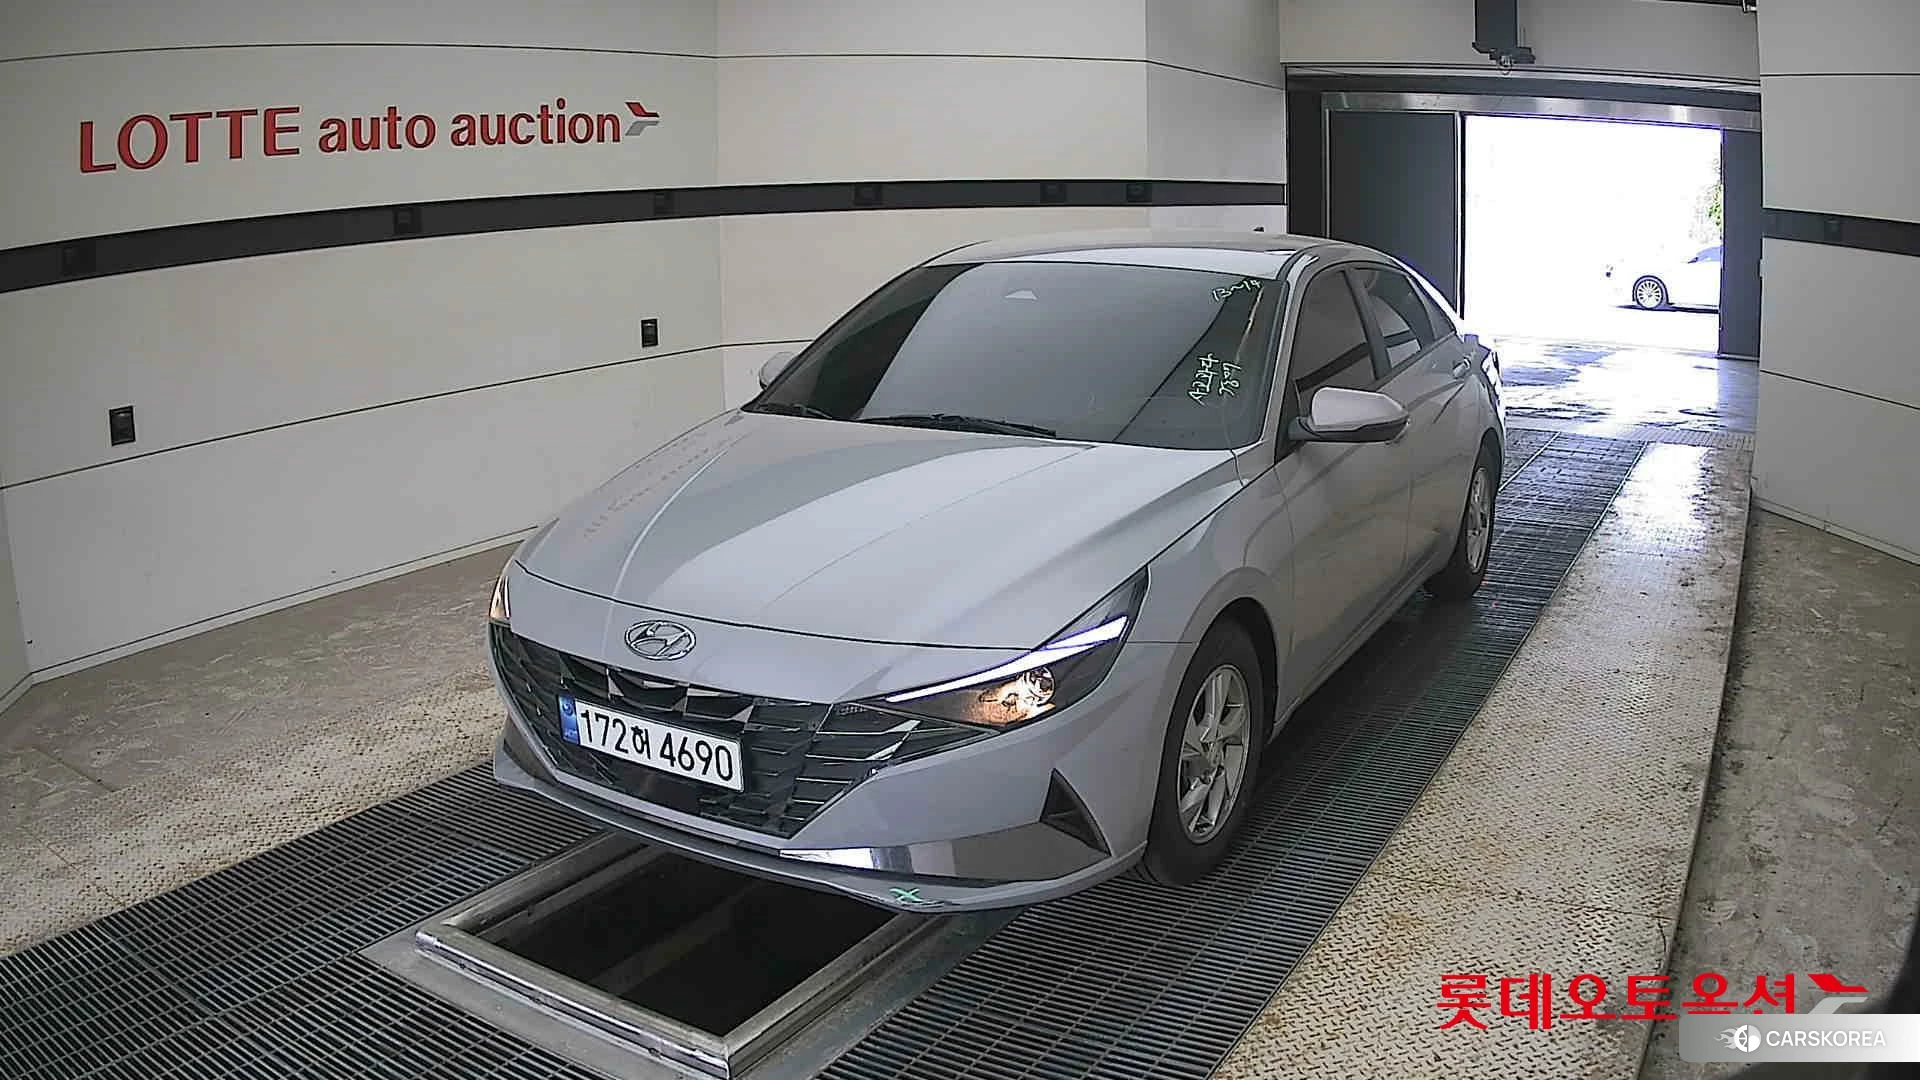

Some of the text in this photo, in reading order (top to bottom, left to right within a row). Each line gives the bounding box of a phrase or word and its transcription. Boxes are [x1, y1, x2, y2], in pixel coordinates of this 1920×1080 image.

[80, 98, 622, 173] LOTTE auto auction
[580, 709, 733, 781] 172허 4690
